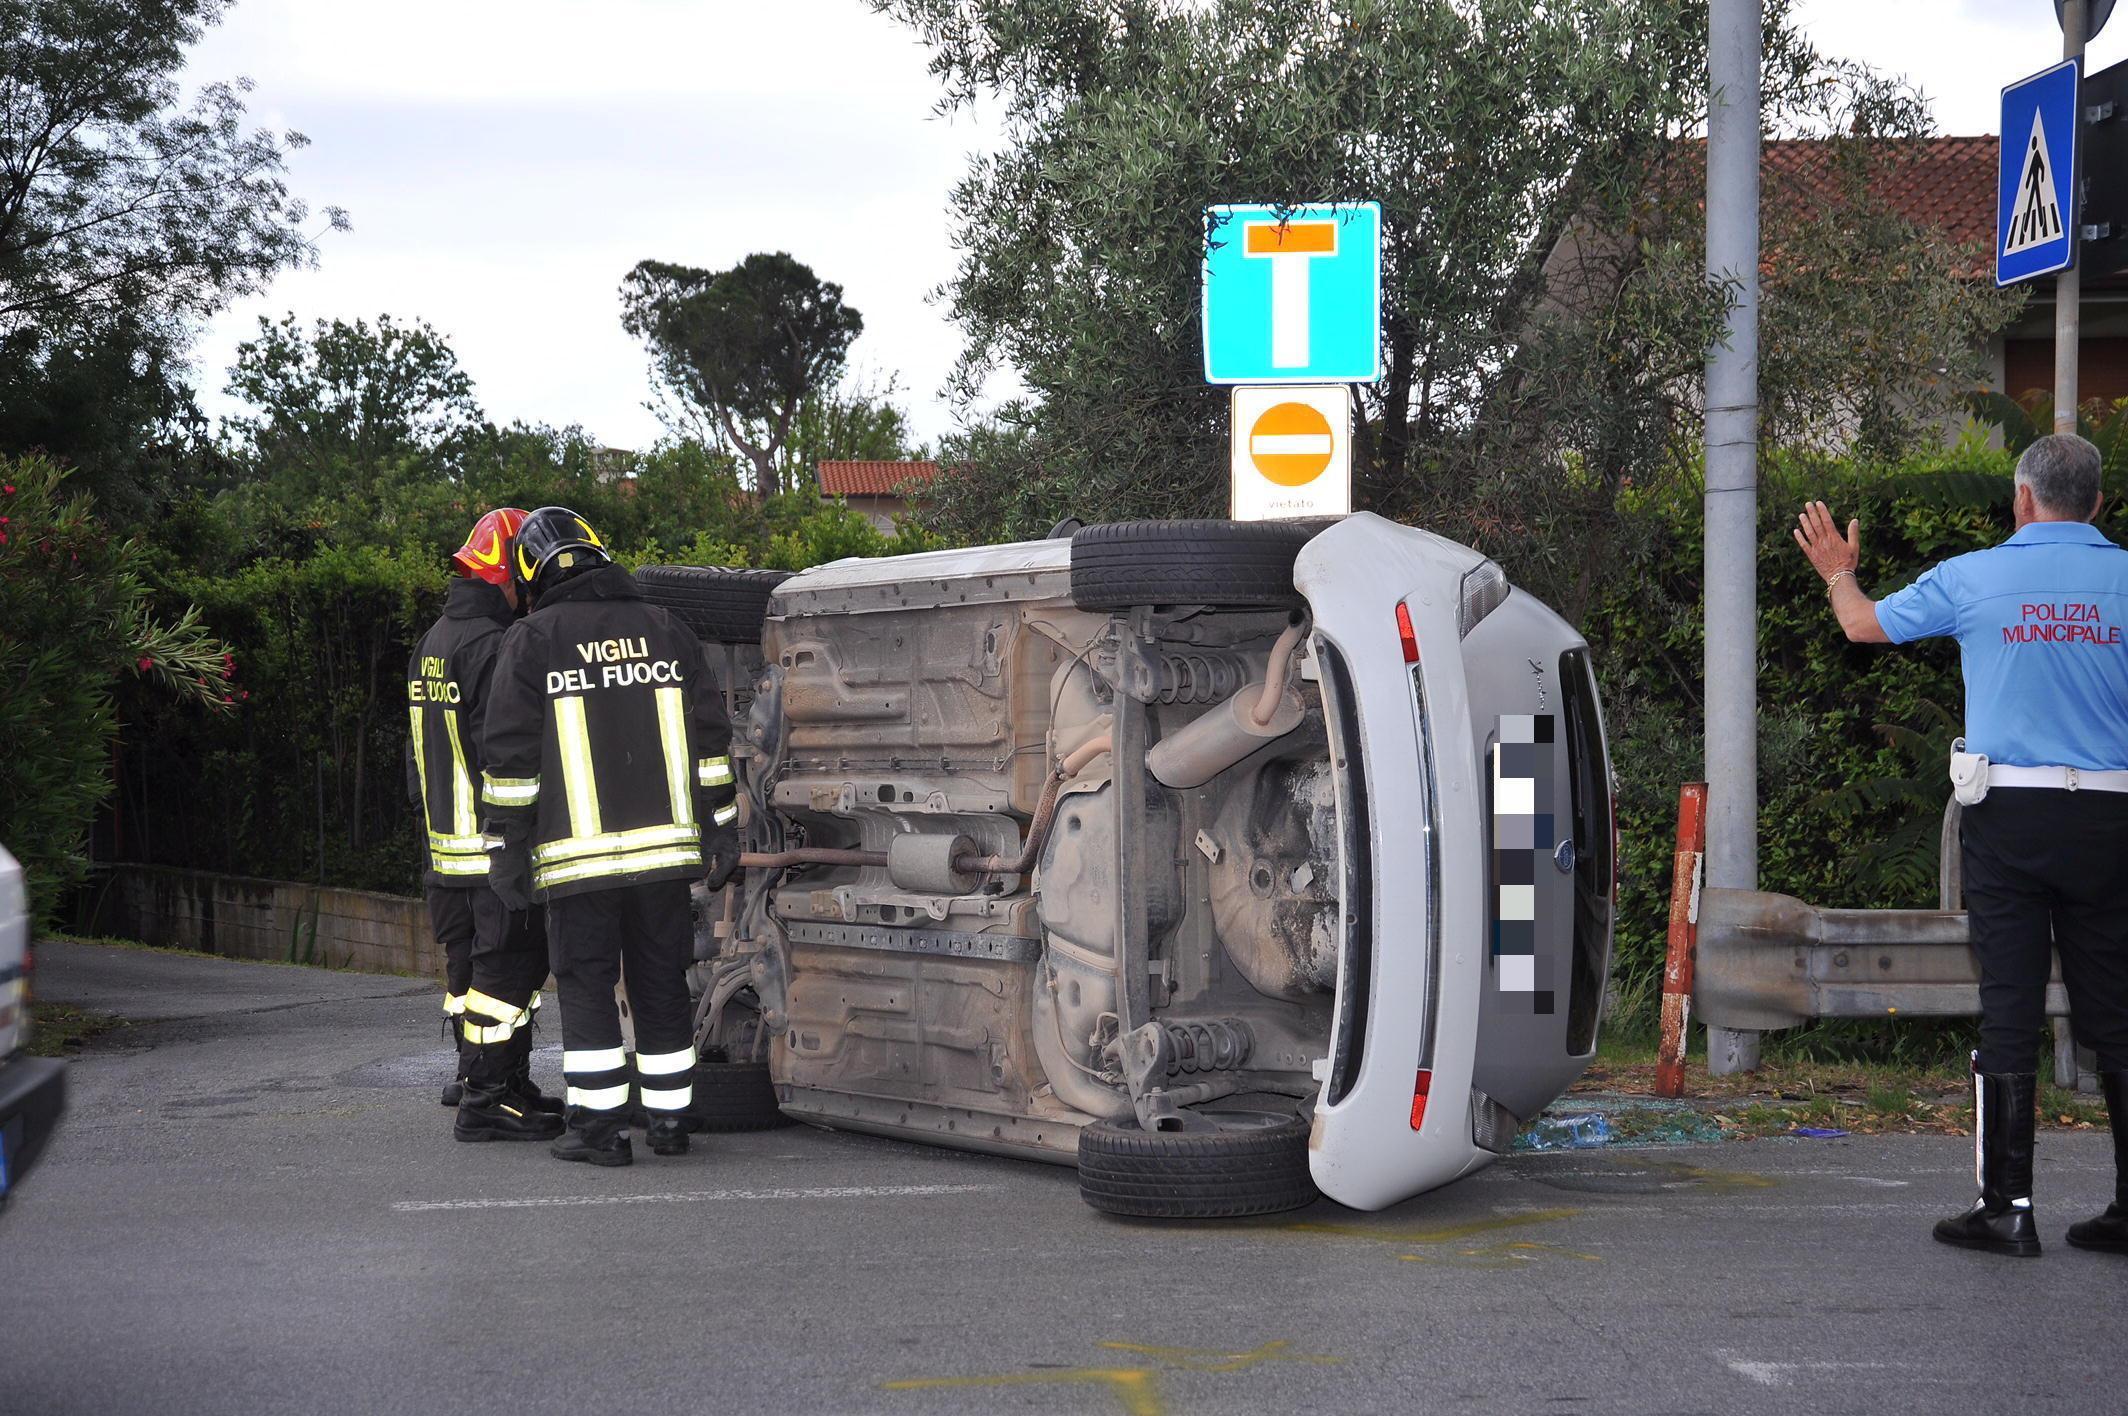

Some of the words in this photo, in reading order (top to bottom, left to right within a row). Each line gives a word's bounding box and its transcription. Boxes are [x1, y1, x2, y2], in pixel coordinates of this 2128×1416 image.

[1268, 499, 1314, 508] vietato
[2022, 604, 2100, 622] POLIZIA
[2002, 624, 2121, 644] MUNICIPALE
[577, 637, 649, 663] VIGILI
[421, 656, 445, 678] VGILI
[408, 680, 426, 701] EL
[546, 668, 596, 694] DEL
